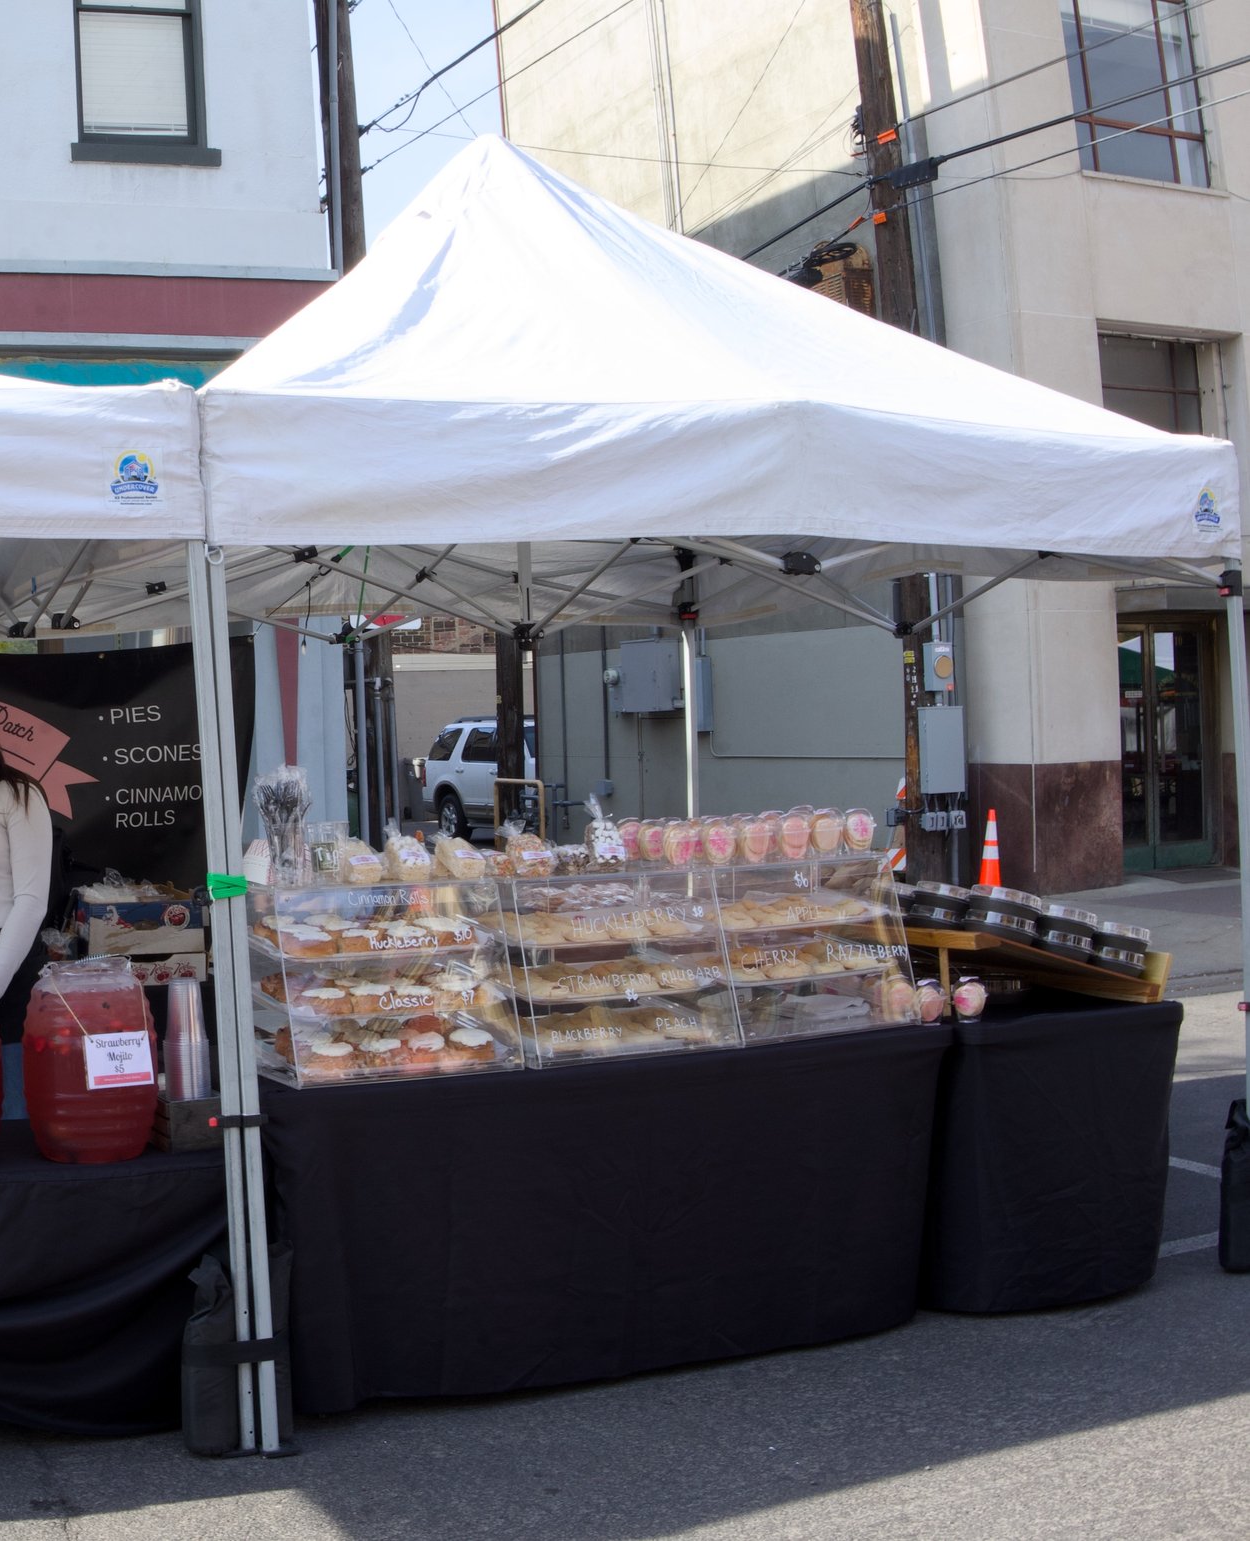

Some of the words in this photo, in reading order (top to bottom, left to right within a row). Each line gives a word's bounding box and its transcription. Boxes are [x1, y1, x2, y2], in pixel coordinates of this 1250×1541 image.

[114, 483, 155, 493] UNDERCOVER
[110, 705, 161, 724] PIES
[114, 744, 202, 765] SCONES
[116, 785, 202, 805] CINNAMO
[116, 810, 175, 828] ROLLS
[347, 890, 397, 905] Cinnamon
[400, 890, 430, 905] Rolls
[571, 906, 687, 937] HUCKLEBERRY
[692, 906, 704, 918] $8
[787, 906, 823, 922] APPLE
[369, 934, 439, 952] Huckleberry
[454, 928, 473, 943] $10
[741, 948, 798, 971] CHERRY
[826, 943, 909, 962] RAZZLEBERRY
[557, 973, 654, 994] STRAWBERRY
[661, 966, 722, 985] RHUBARB
[379, 992, 434, 1010] Classic
[462, 990, 475, 1006] $7
[551, 1026, 623, 1044] BLACKBERRY
[655, 1017, 698, 1031] PEACH
[95, 1037, 141, 1048] Strawberry
[107, 1051, 133, 1063] Mojito
[114, 1064, 125, 1073] $5
